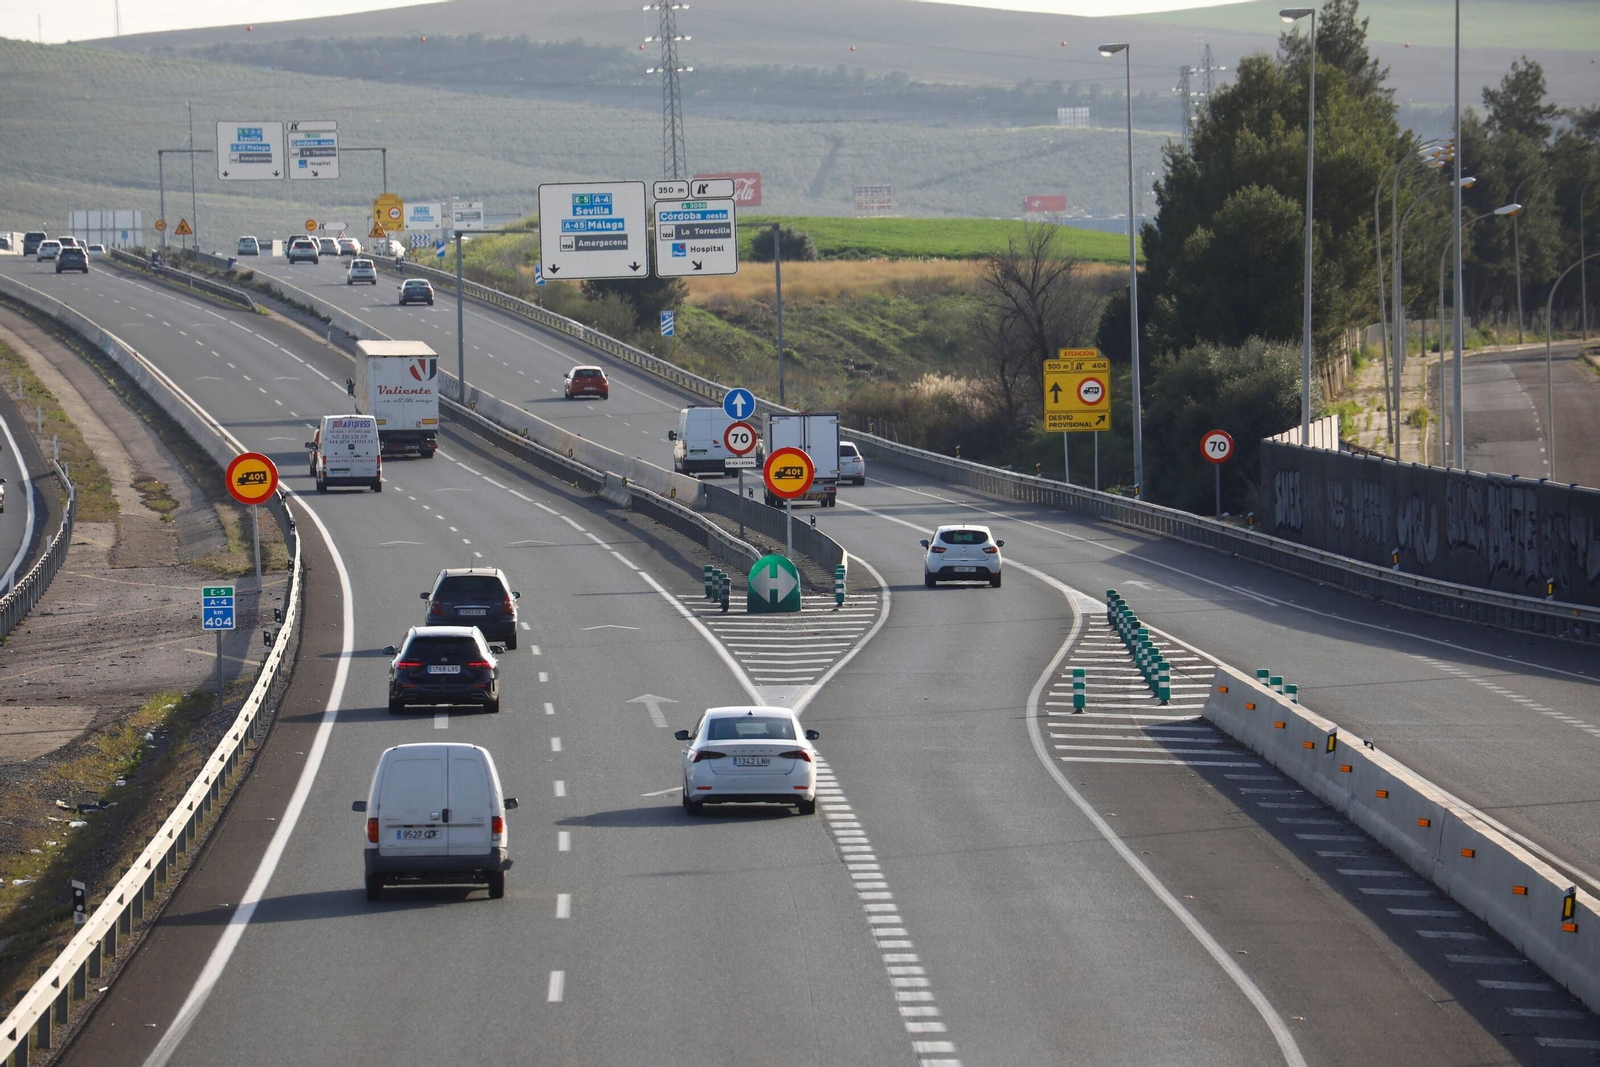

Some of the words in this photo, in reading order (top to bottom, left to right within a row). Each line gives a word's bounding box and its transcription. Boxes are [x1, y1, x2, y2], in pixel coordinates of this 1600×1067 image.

[575, 196, 589, 204] E-5
[575, 206, 610, 215] Sevilla
[660, 211, 702, 221] Córdoba
[588, 220, 624, 231] Málaga
[694, 227, 731, 235] Torrecilla
[578, 239, 627, 248] Amargacena
[690, 245, 725, 253] Hospital
[377, 385, 432, 395] Valiente
[1048, 413, 1074, 421] DESVÍO
[731, 433, 749, 444] 70
[1209, 441, 1227, 452] 70
[785, 468, 801, 476] 40t
[205, 617, 232, 627] 404
[431, 665, 447, 673] 1768
[402, 830, 423, 839] 9527
[77, 913, 83, 921] 9
